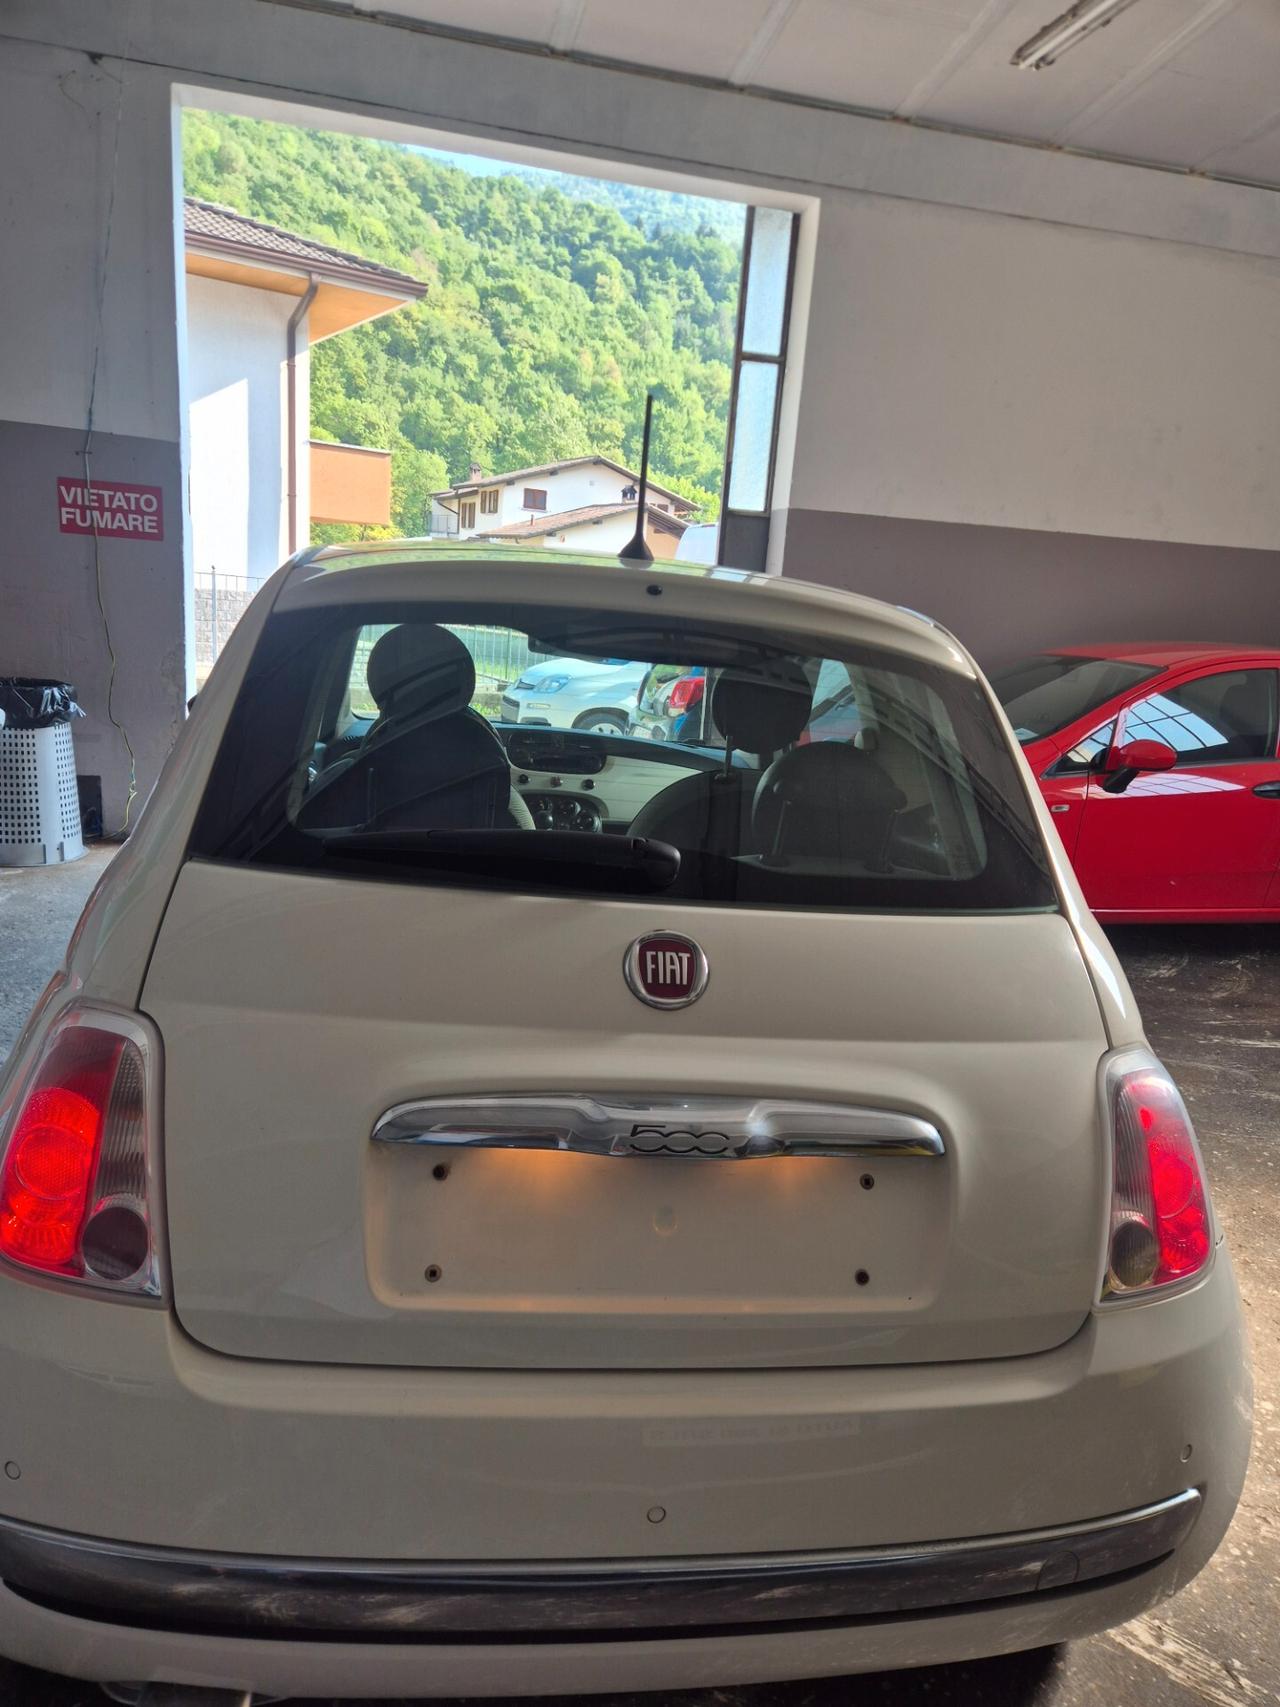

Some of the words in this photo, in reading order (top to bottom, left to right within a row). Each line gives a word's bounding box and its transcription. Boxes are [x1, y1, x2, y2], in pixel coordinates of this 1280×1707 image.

[60, 486, 158, 512] VIETATO
[61, 507, 159, 533] FUMARE
[646, 951, 690, 985] FIAT
[630, 1124, 729, 1154] 500
